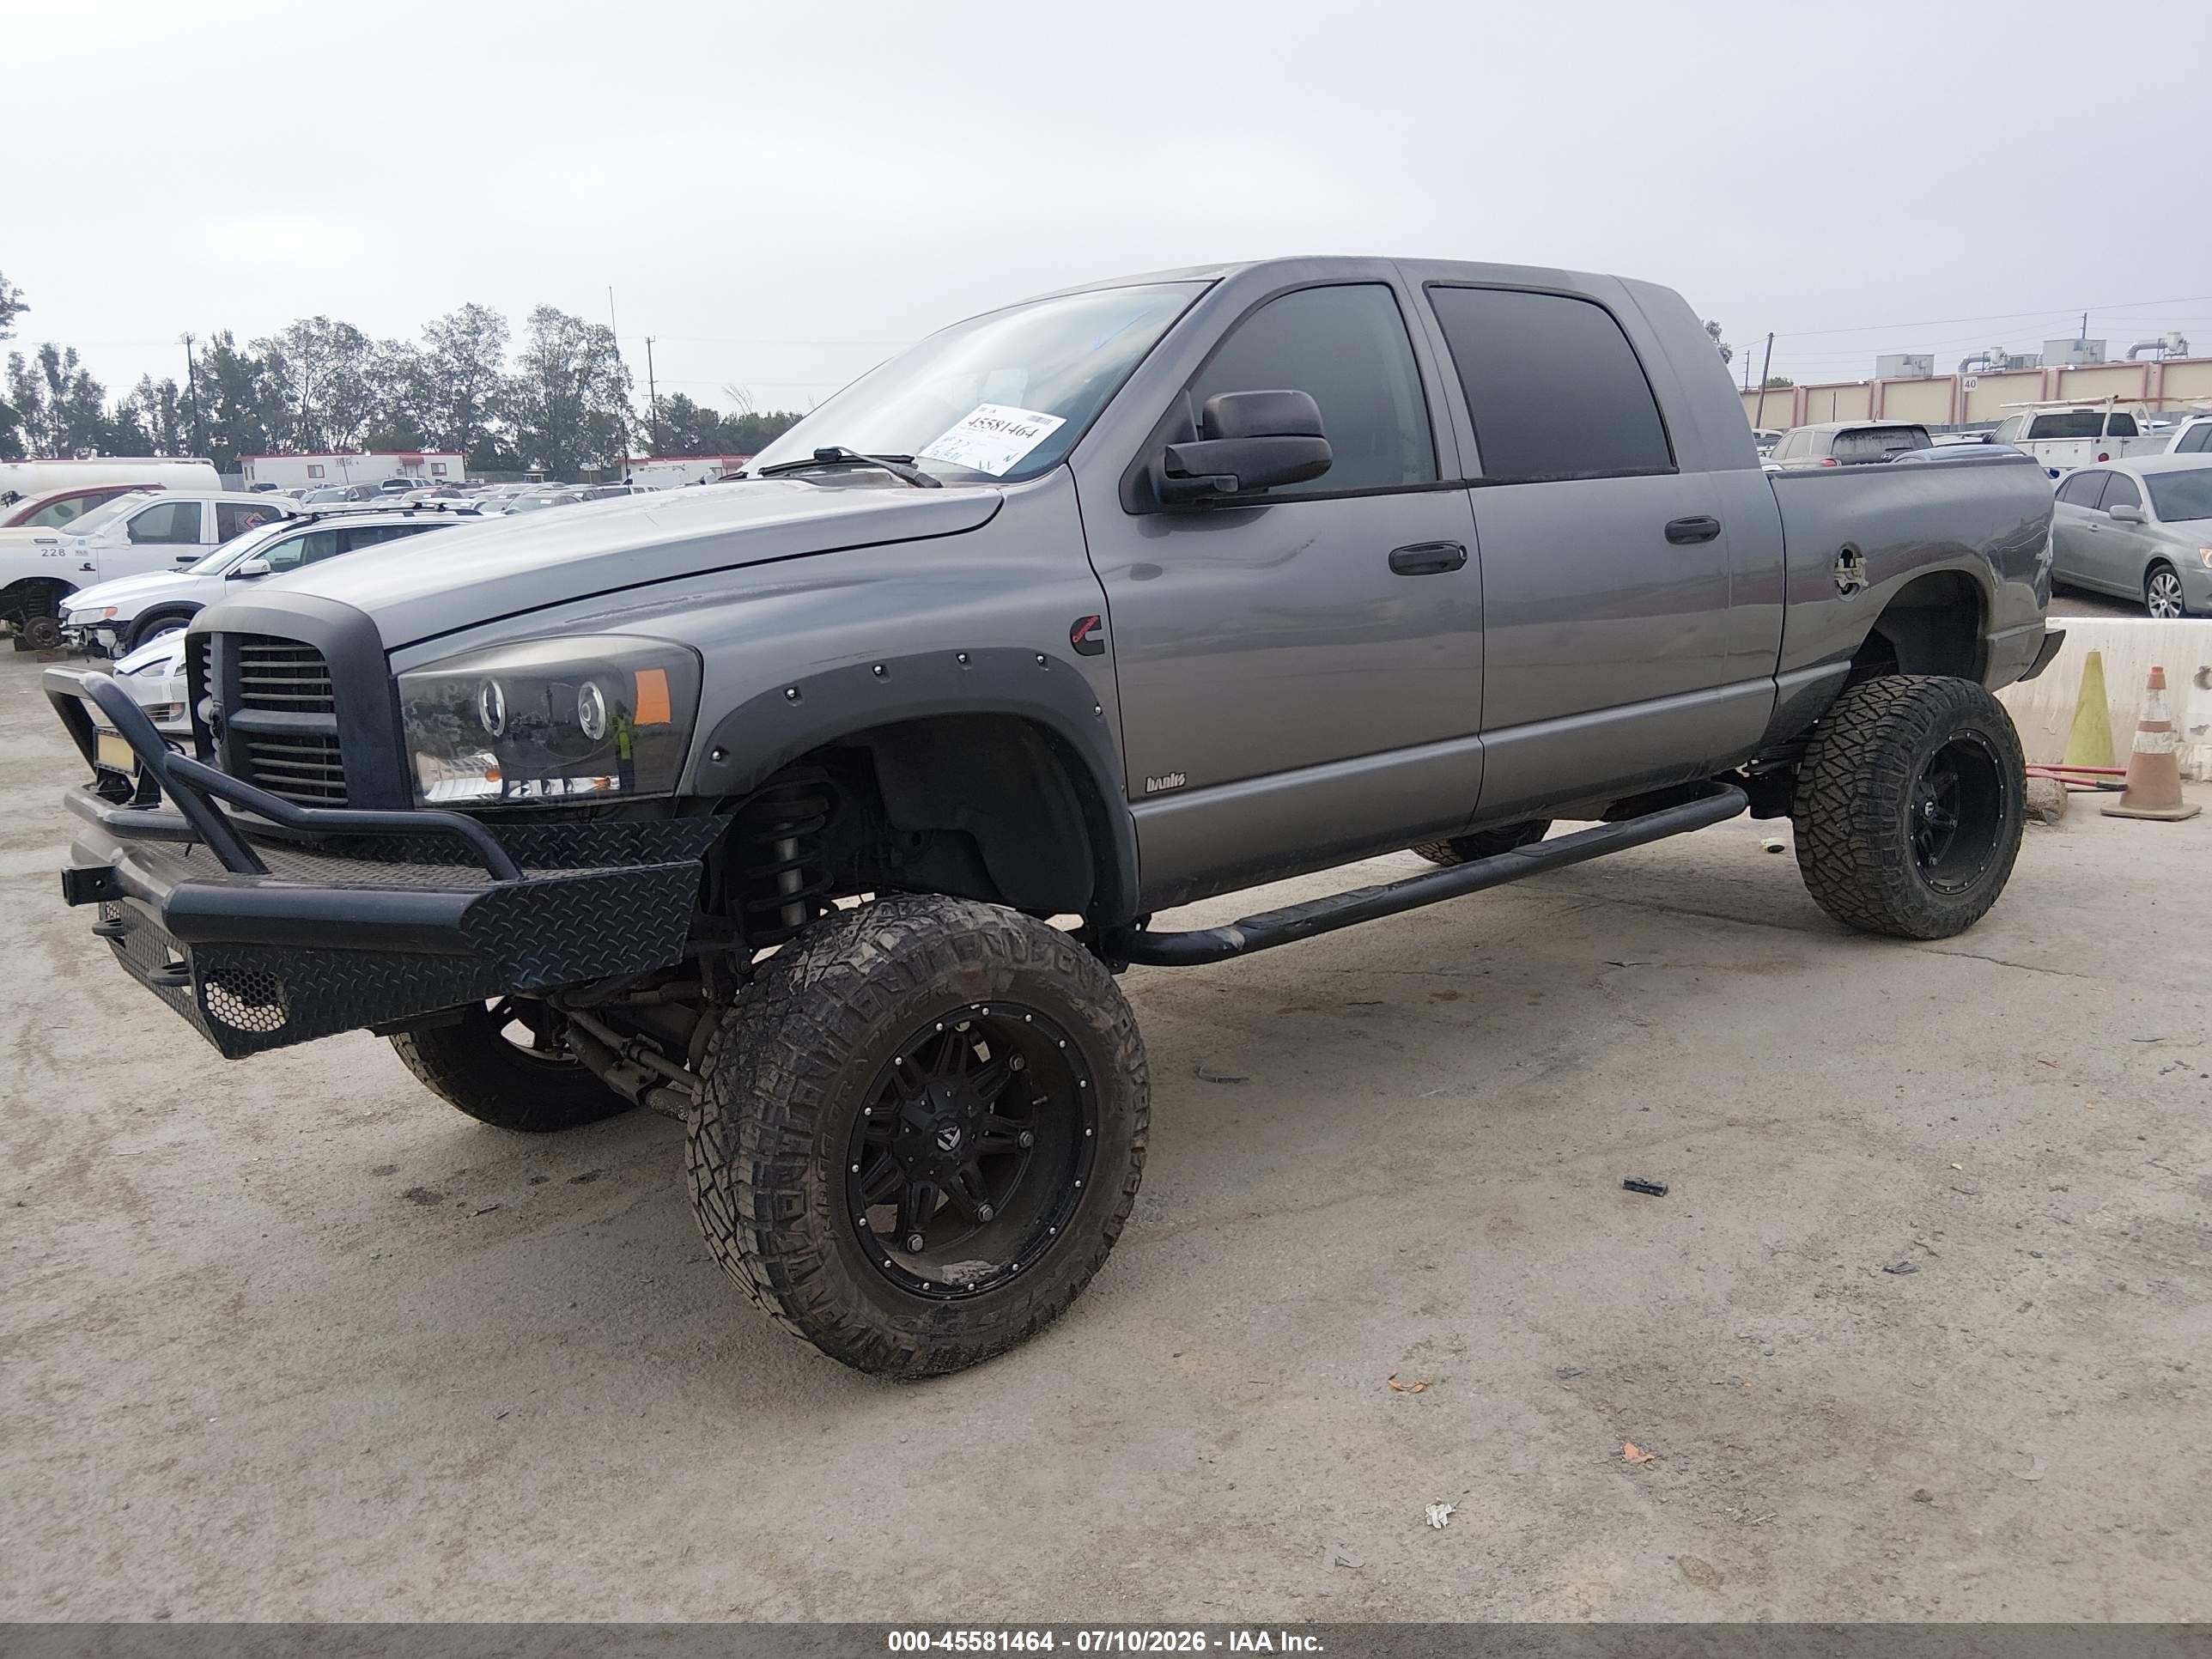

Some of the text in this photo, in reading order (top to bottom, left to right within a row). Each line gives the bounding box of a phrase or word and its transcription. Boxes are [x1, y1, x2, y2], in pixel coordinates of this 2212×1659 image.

[1964, 379, 1977, 389] 40
[968, 416, 1040, 439] 45581464
[40, 548, 66, 557] 228
[1146, 772, 1187, 793] banks
